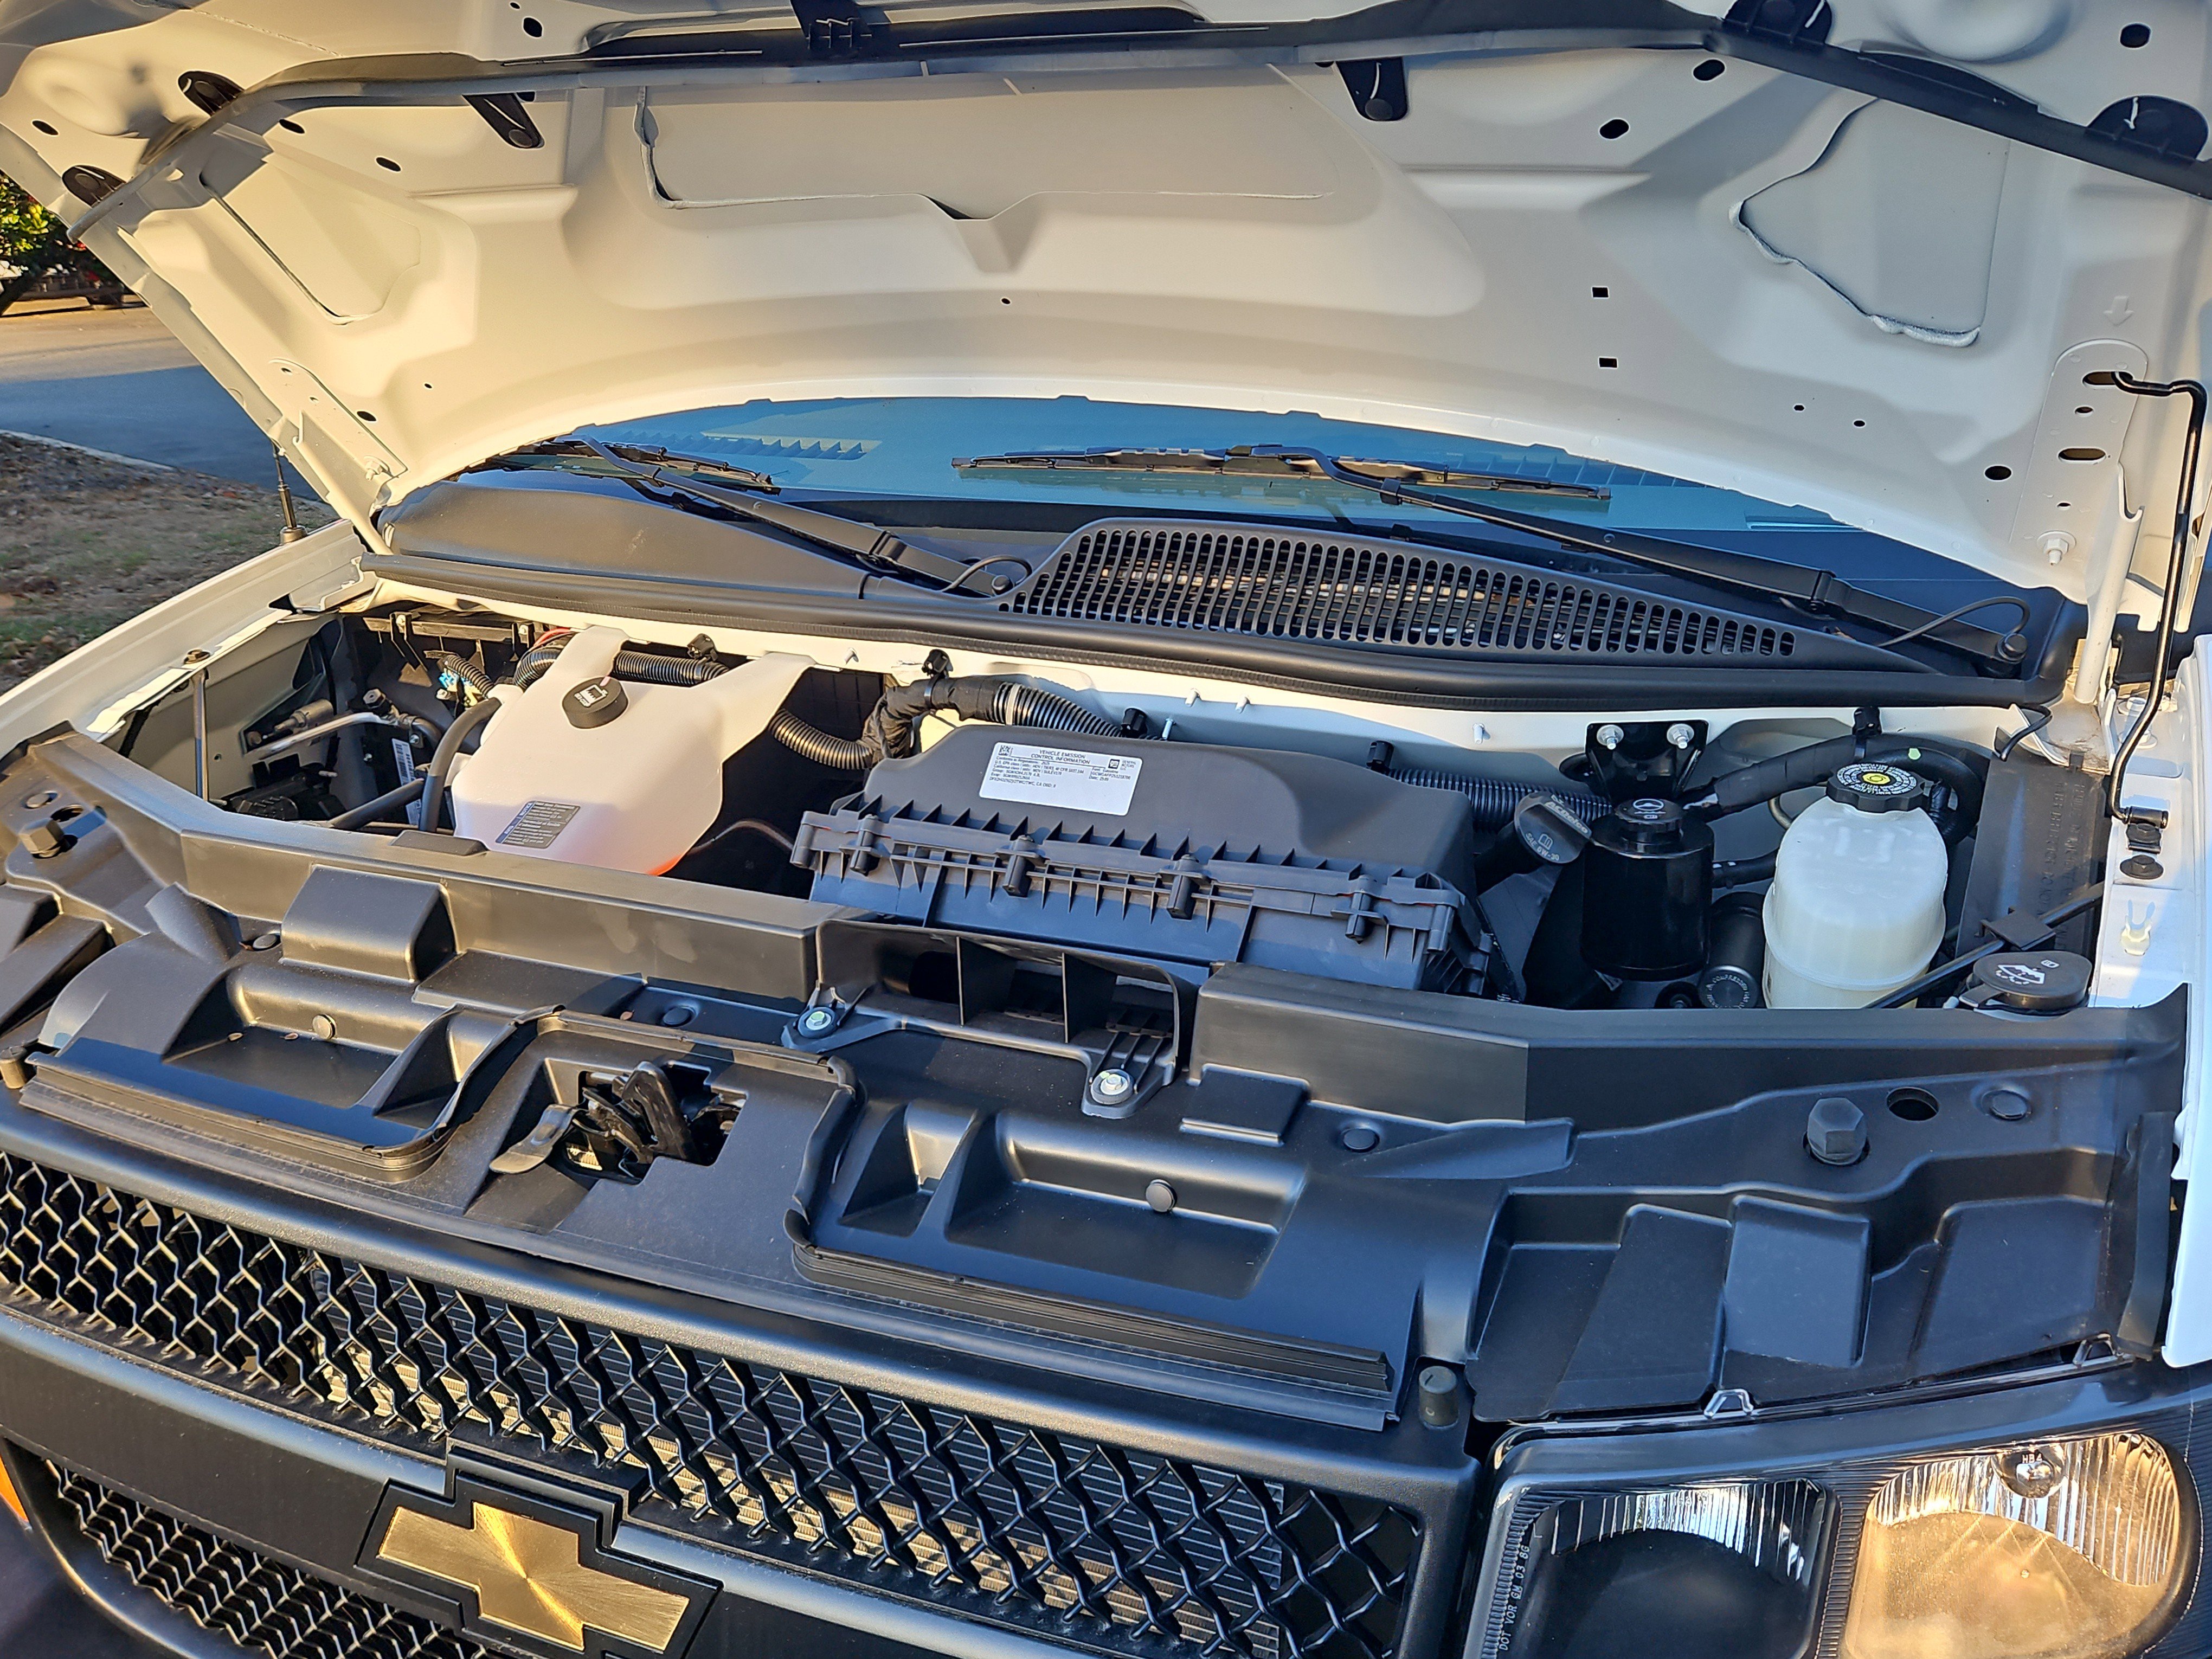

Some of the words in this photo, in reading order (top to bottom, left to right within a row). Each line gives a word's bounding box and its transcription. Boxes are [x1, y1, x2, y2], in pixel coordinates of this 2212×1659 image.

[1544, 801, 1589, 834] ACDelco
[1526, 833, 1538, 847] SAE
[2022, 1453, 2043, 1464] HB4
[1515, 1565, 1526, 1579] 03
[1510, 1585, 1523, 1600] GM
[1504, 1605, 1517, 1624] VOR
[1499, 1630, 1512, 1651] DOT
